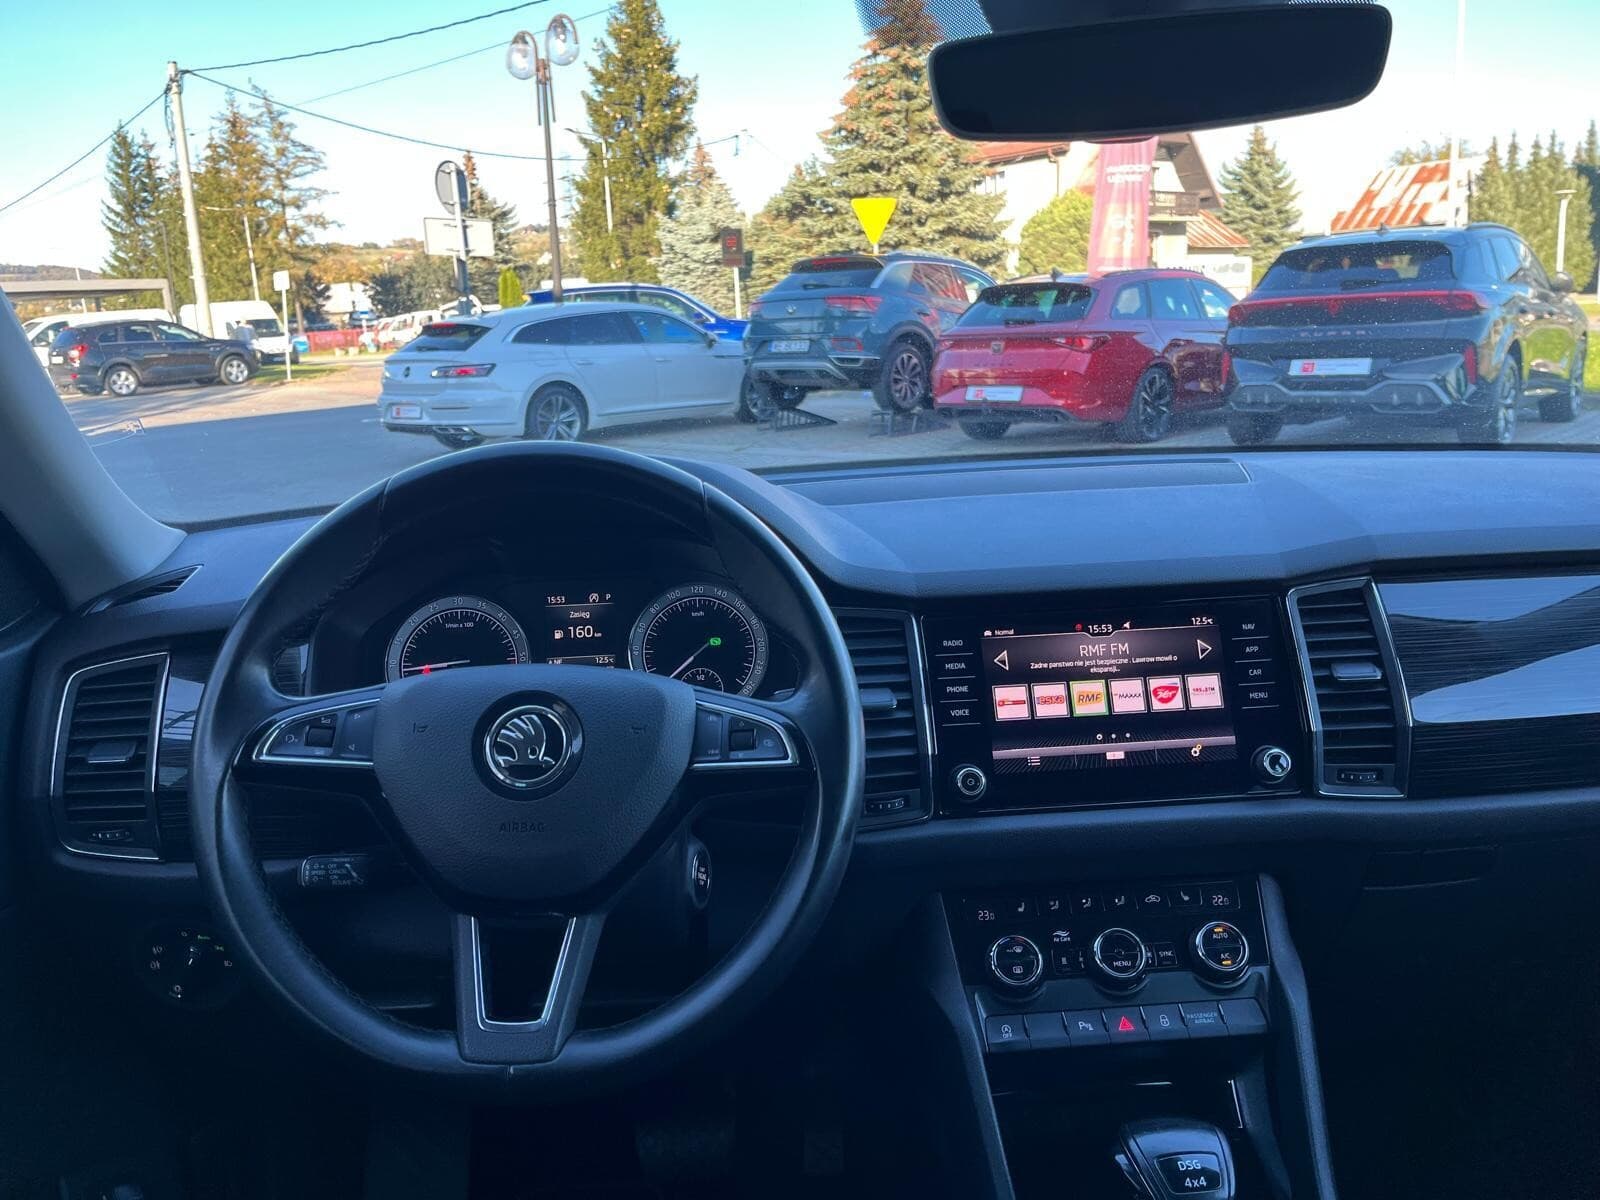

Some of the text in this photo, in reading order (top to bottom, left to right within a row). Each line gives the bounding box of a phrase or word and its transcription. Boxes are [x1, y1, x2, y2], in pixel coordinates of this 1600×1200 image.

[666, 590, 681, 600] 100
[690, 586, 704, 594] 120
[714, 588, 728, 598] 140
[454, 597, 464, 606] 30
[477, 600, 486, 609] 35
[732, 598, 746, 610] 160
[650, 603, 660, 614] 80
[408, 616, 419, 626] 20
[750, 616, 760, 630] 180
[568, 625, 594, 638] 160
[638, 622, 646, 633] 60
[1088, 624, 1112, 634] 15:53
[632, 645, 640, 656] 40
[1080, 642, 1130, 657] RMF FM
[1078, 694, 1103, 704] RMF
[950, 708, 970, 716] VOICE
[498, 822, 544, 832] AIRBAG
[1177, 1160, 1202, 1171] DSG
[1184, 1176, 1207, 1188] 4x4
